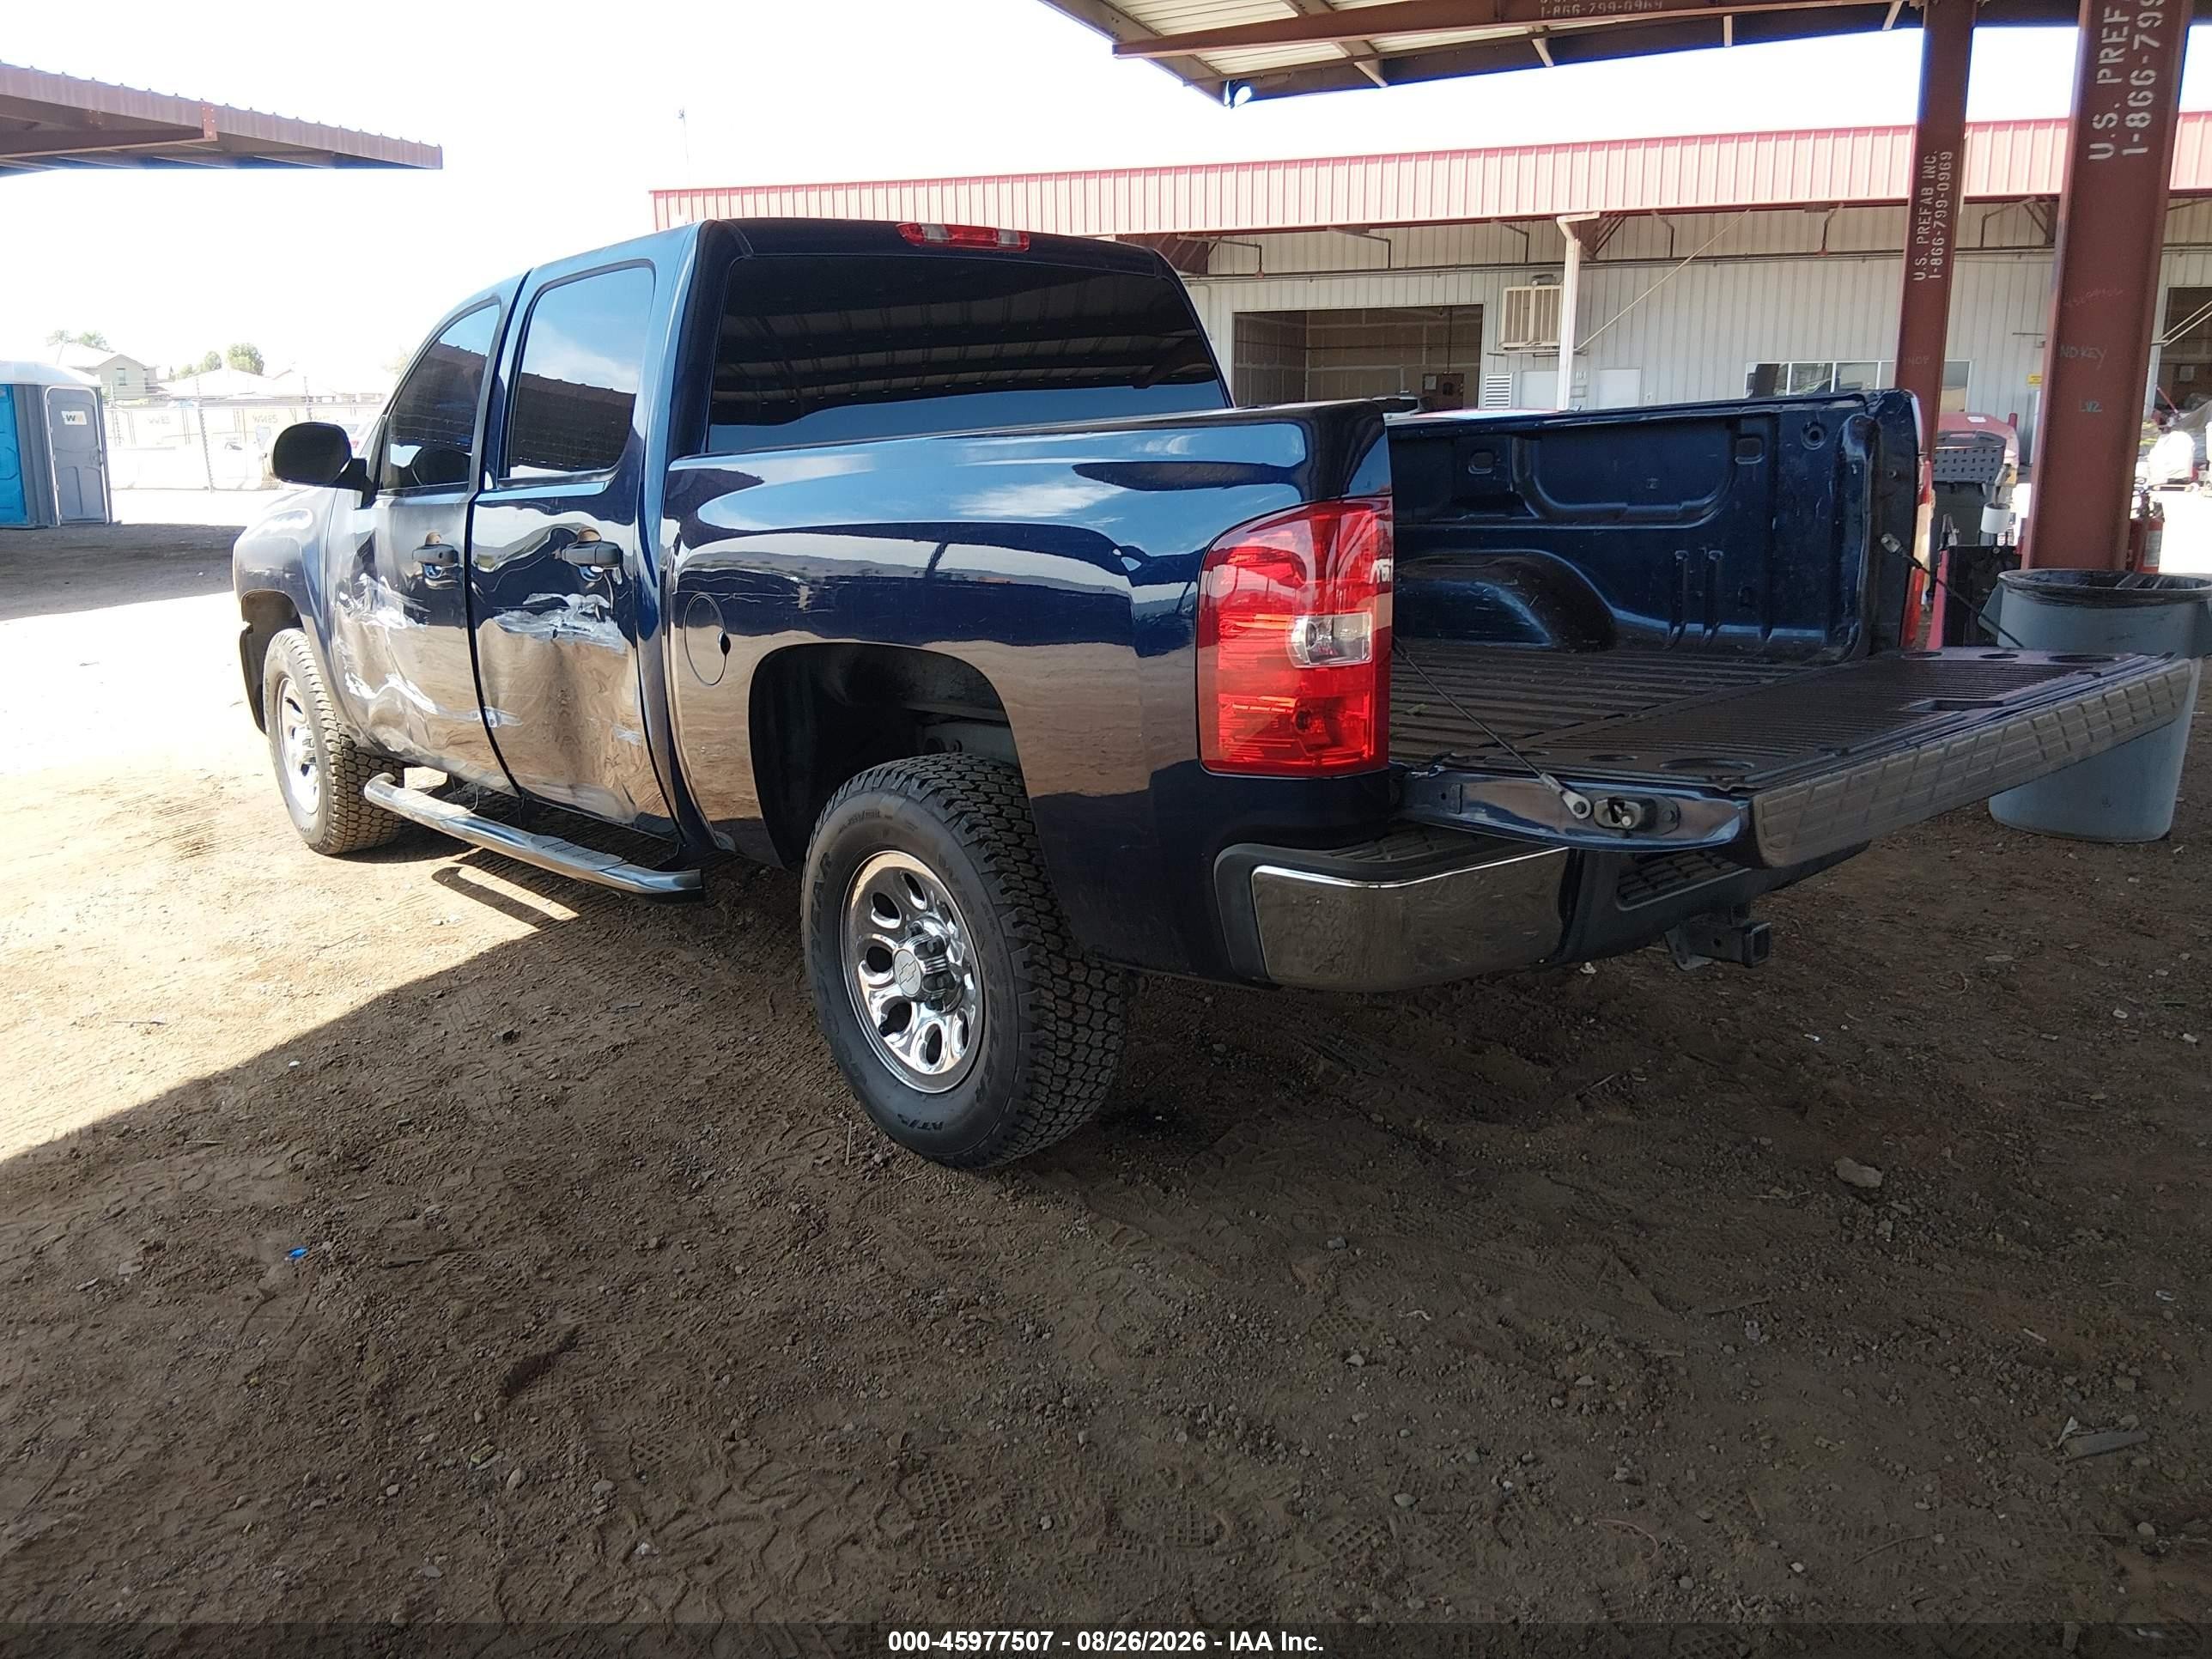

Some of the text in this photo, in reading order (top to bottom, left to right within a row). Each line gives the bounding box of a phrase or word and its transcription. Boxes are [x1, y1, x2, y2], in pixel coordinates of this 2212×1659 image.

[2088, 0, 2130, 161] U.S. PREF
[1913, 150, 1938, 281] U.S. PREFAB INC.
[1929, 150, 1953, 280] 1-866-799-0969
